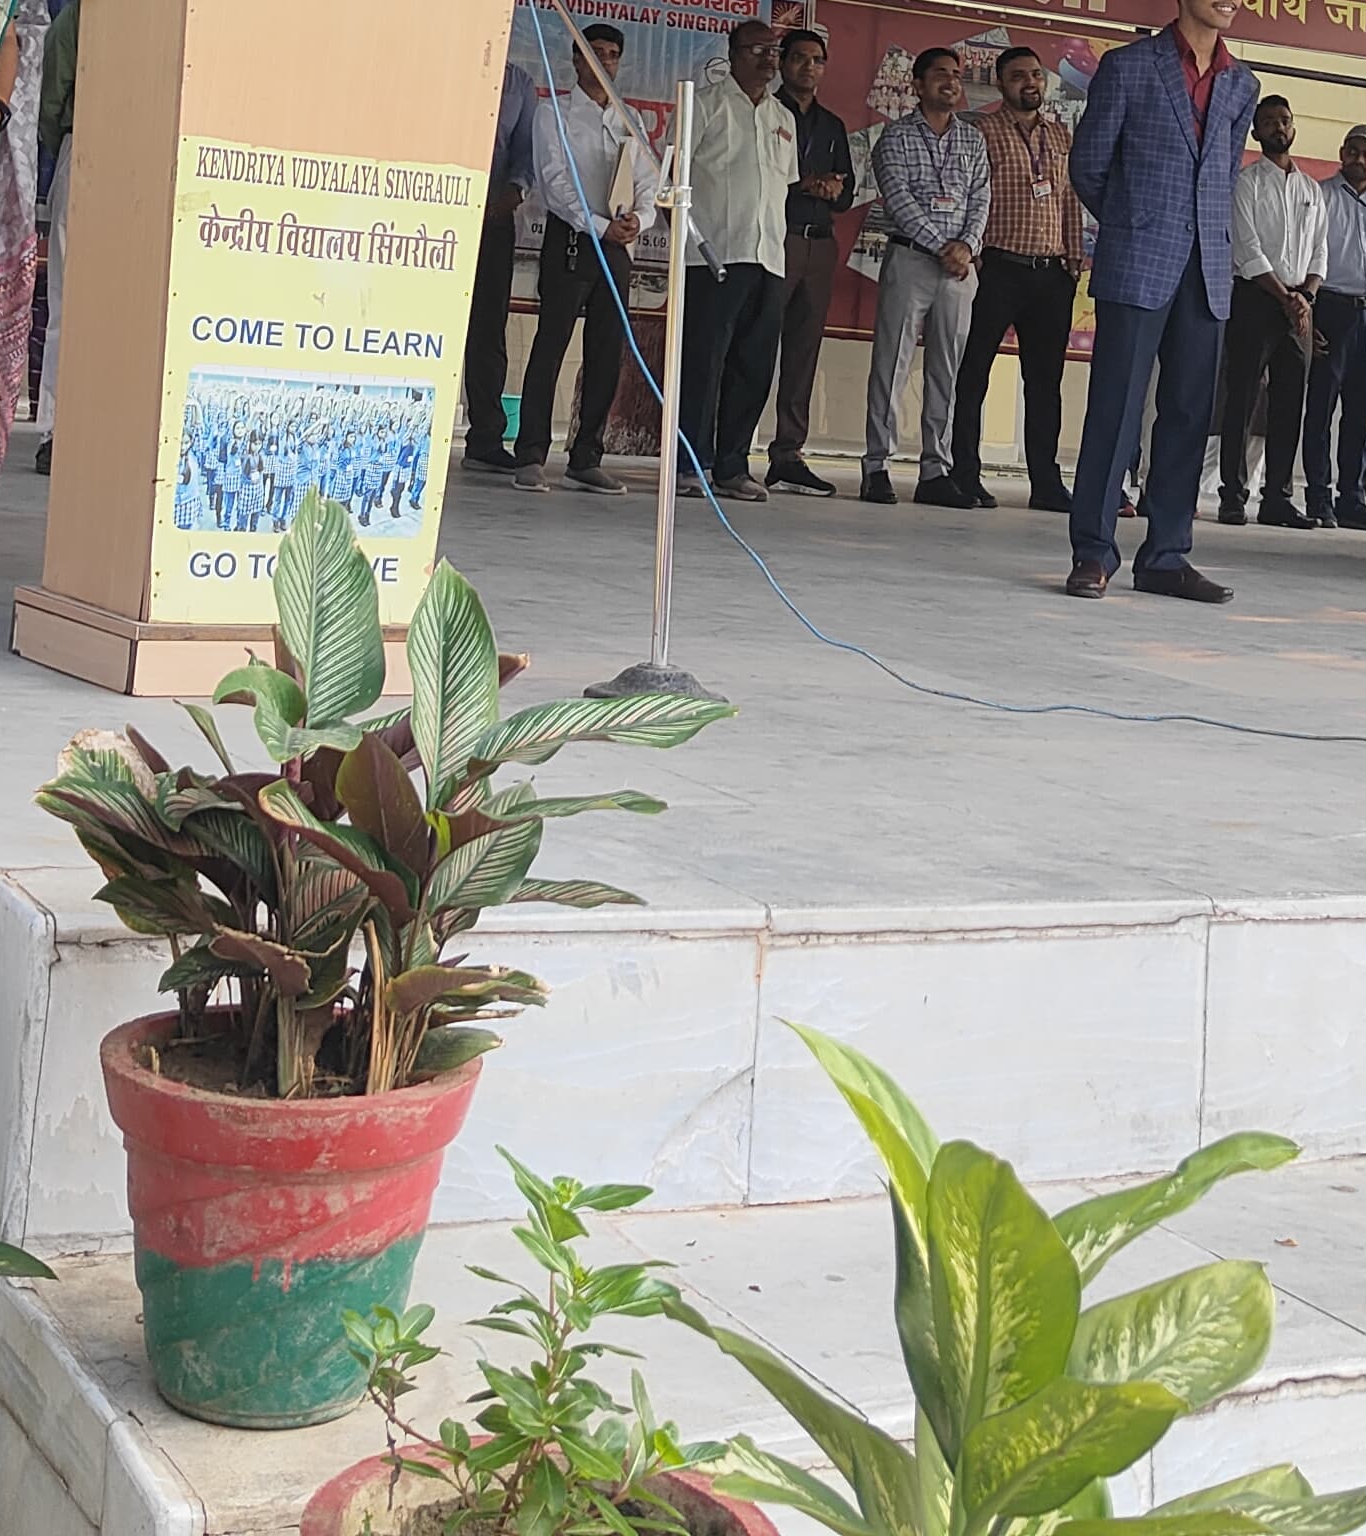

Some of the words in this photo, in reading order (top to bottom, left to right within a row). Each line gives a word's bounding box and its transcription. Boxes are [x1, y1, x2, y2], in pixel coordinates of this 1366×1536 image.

[666, 11, 735, 35] SINGRA
[196, 146, 285, 186] KENDRIYA
[291, 157, 380, 196] VIDYALAYA
[384, 168, 472, 206] SINGRAULI
[198, 203, 274, 253] केन्द्रीय
[275, 213, 365, 263] विद्यालय
[367, 221, 458, 271] सिंगरौली
[191, 315, 284, 349] COME
[294, 324, 334, 351] TO
[344, 327, 444, 359] LEARN
[189, 551, 236, 579] GO
